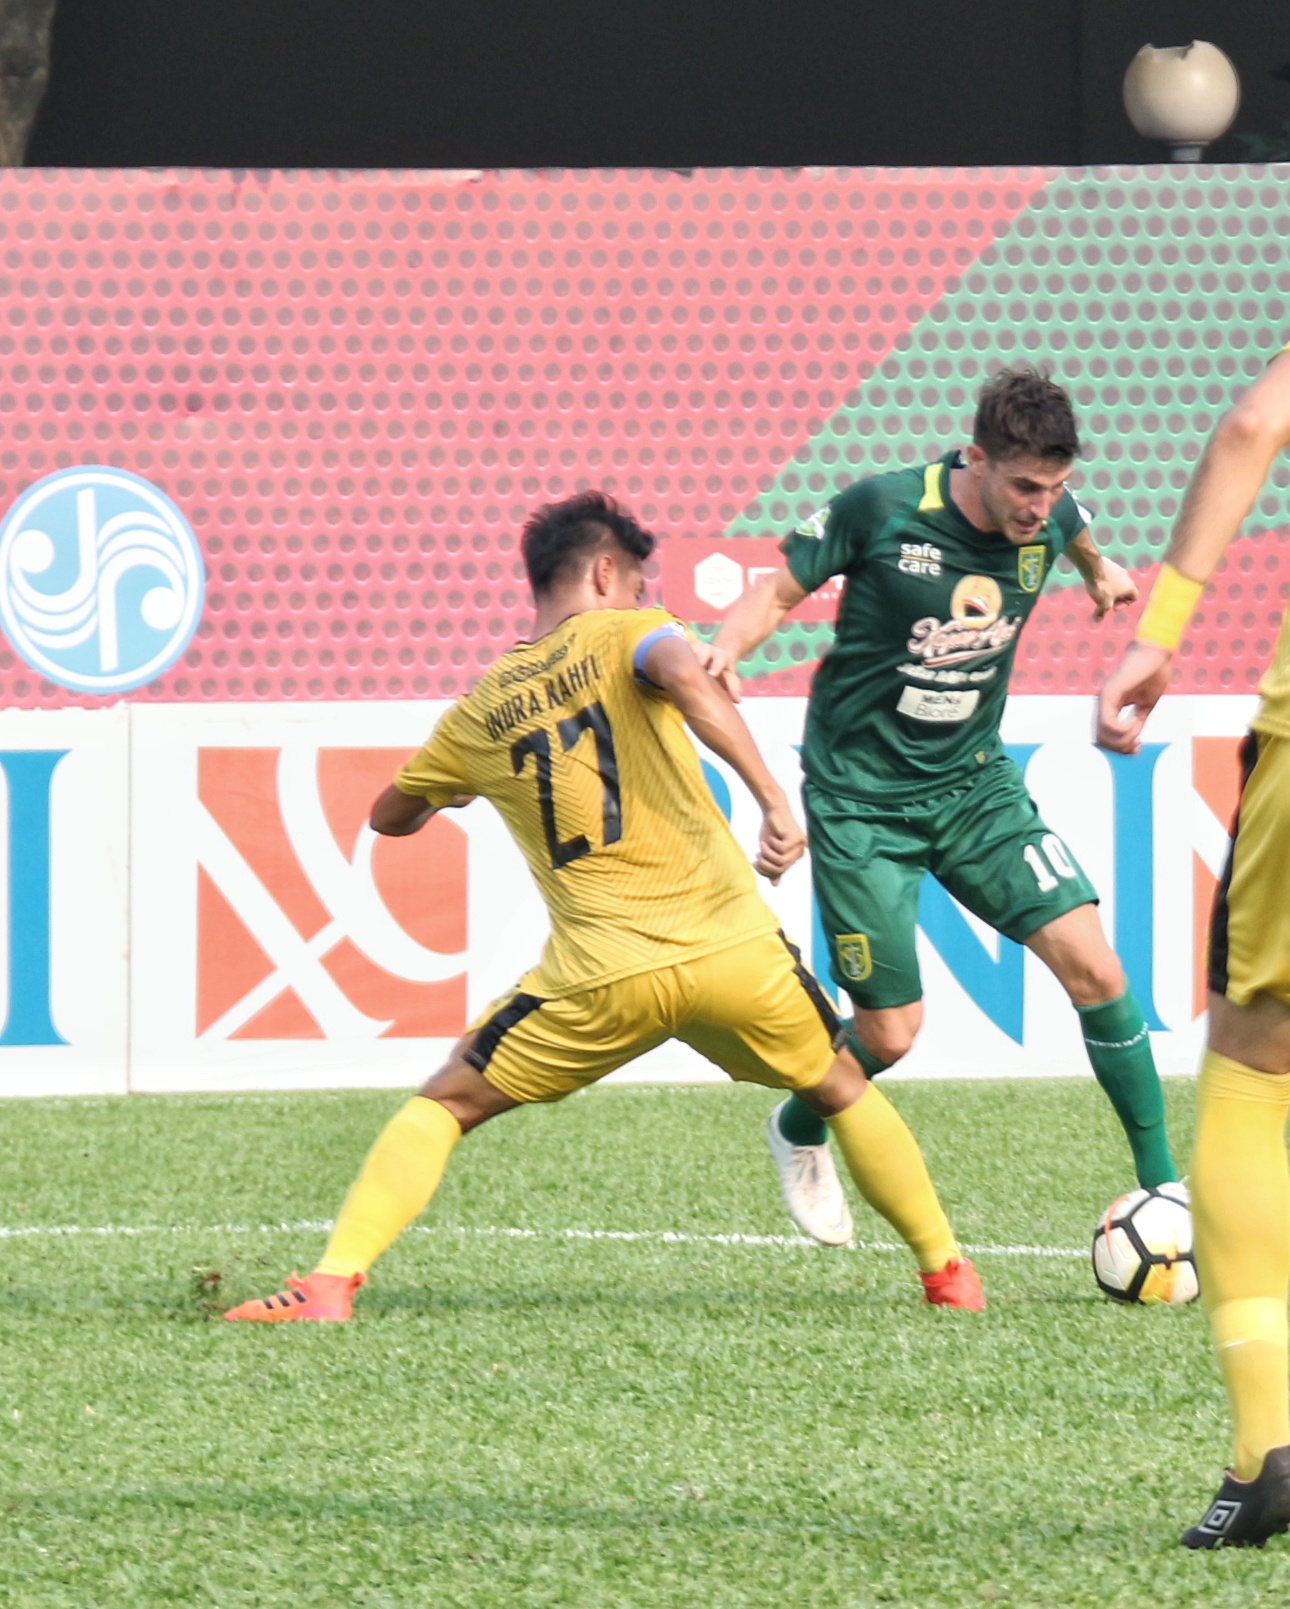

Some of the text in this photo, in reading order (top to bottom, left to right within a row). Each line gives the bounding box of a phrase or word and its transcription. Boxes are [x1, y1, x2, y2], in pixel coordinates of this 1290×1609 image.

[898, 558, 942, 576] care
[900, 543, 942, 560] safe
[485, 690, 543, 741] INDRA
[544, 654, 600, 710] KAHFI
[511, 702, 622, 869] 27
[1023, 833, 1077, 893] 10
